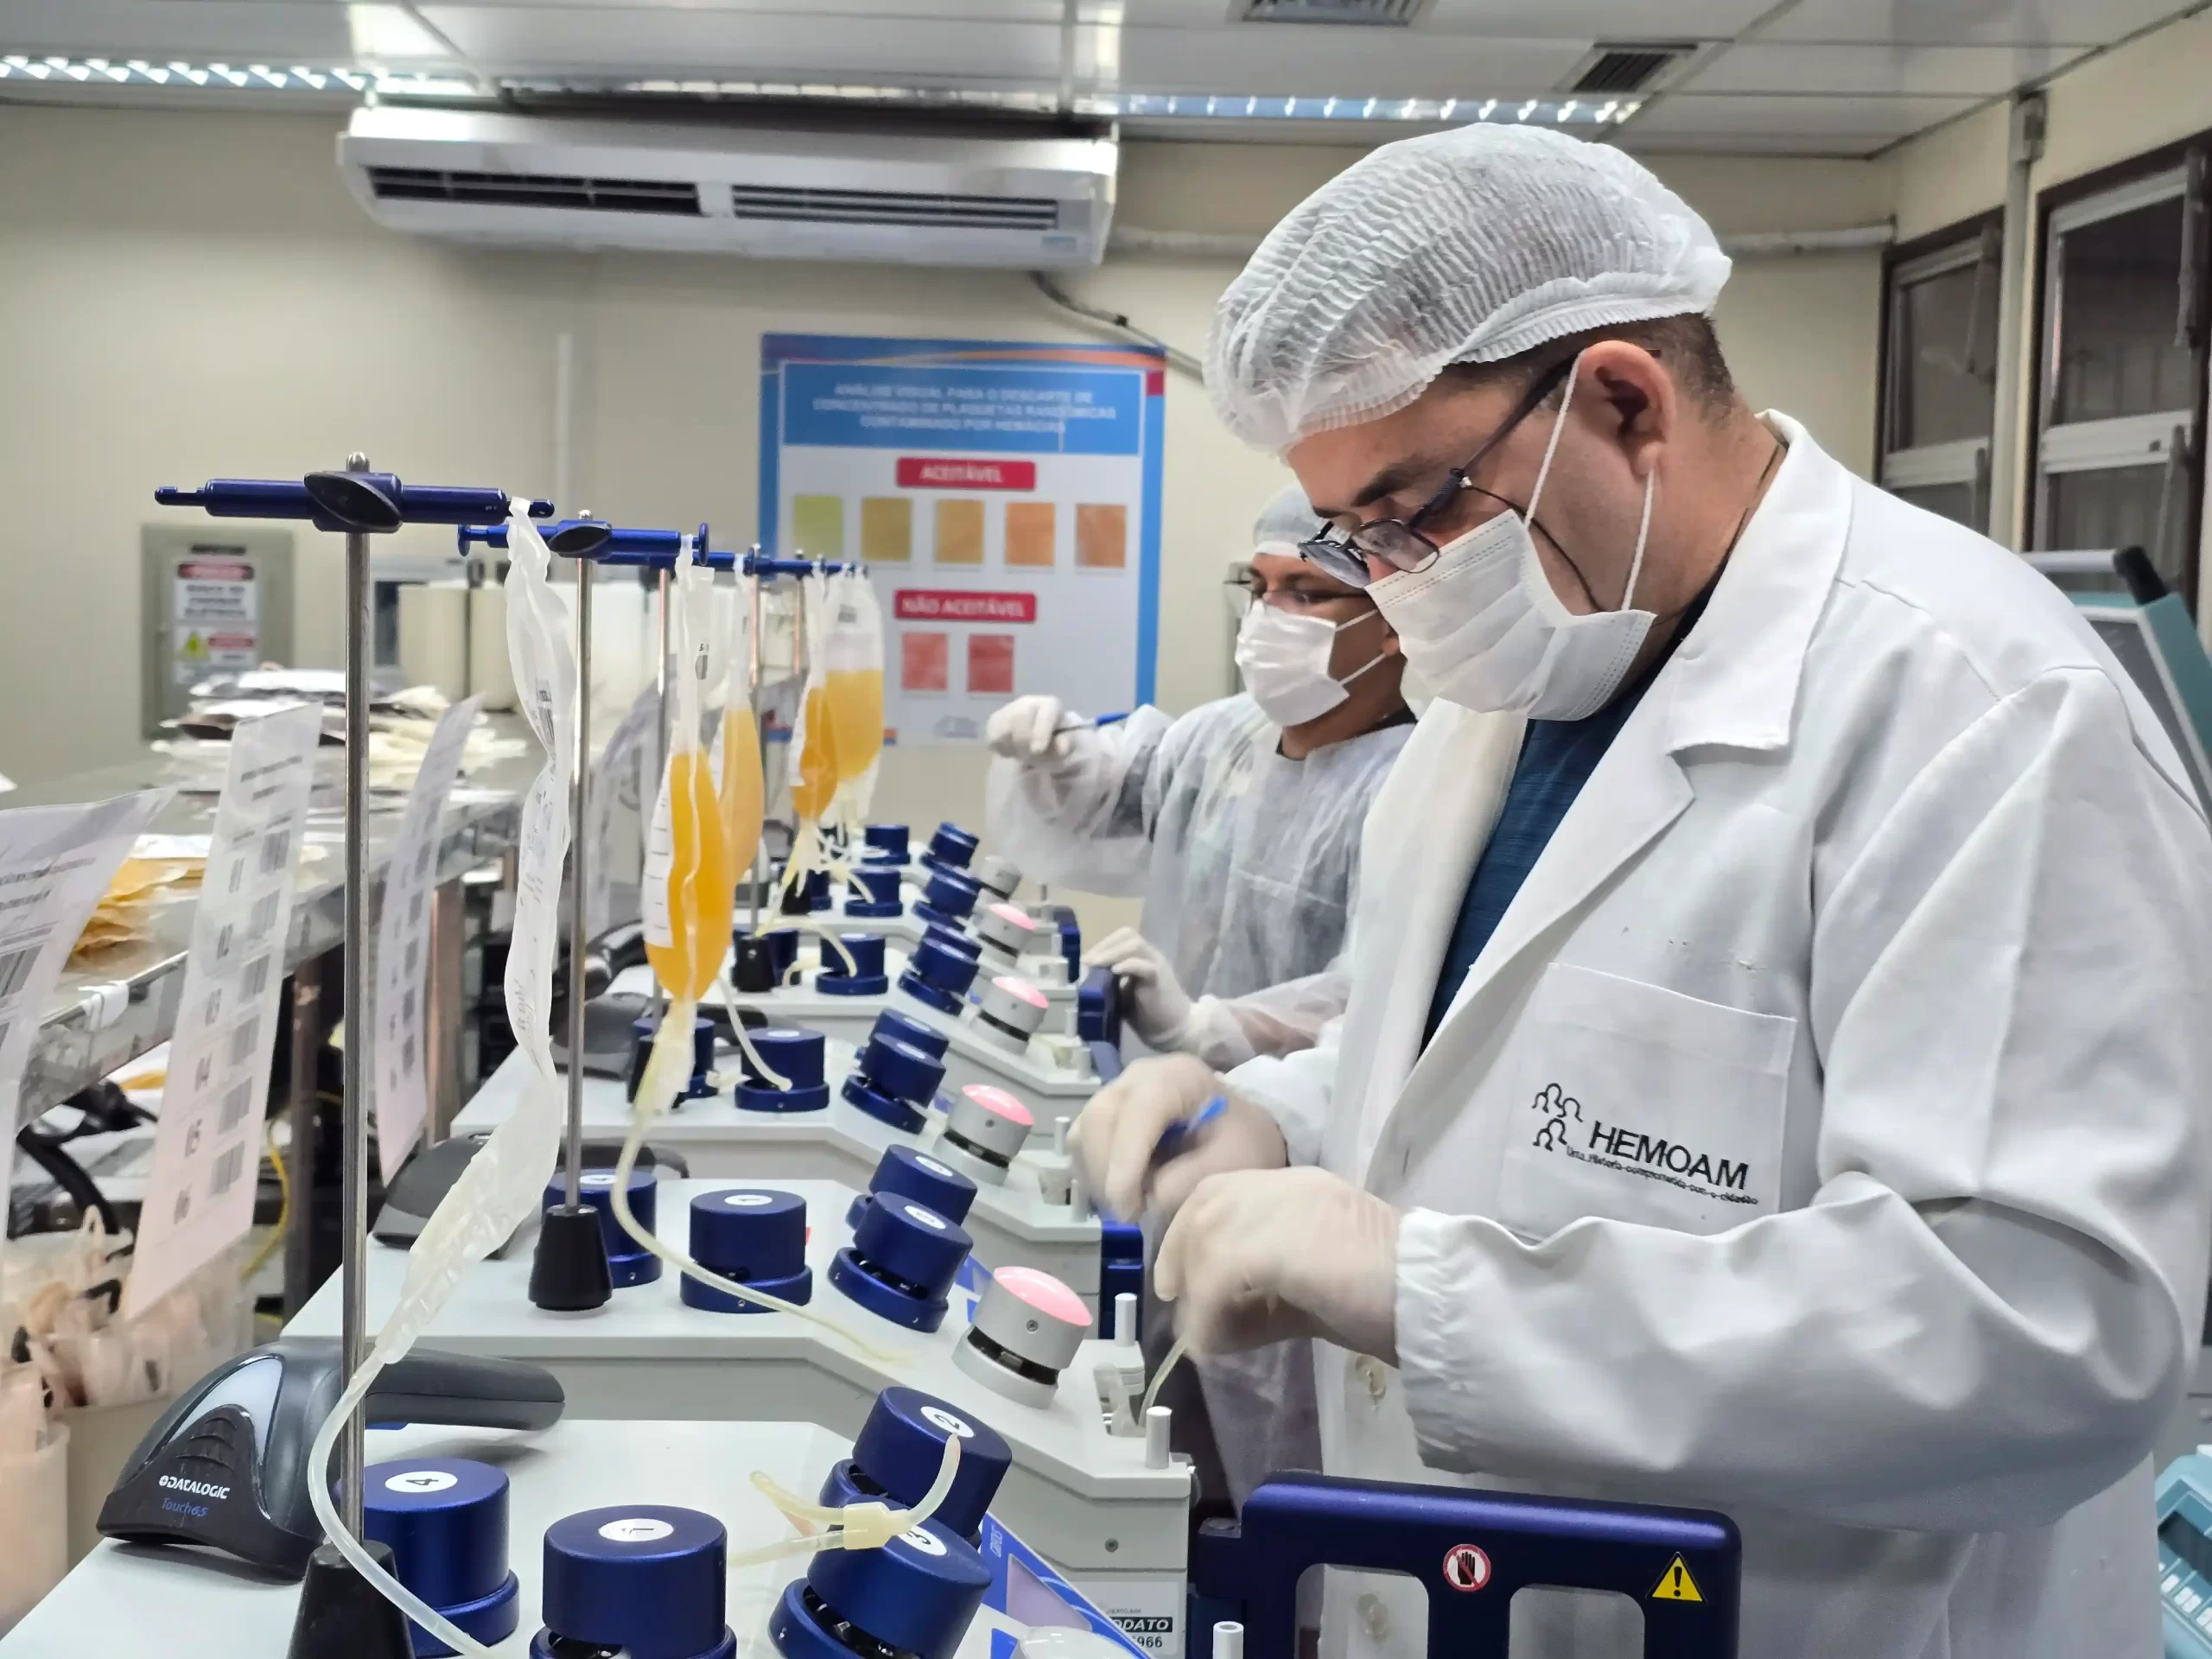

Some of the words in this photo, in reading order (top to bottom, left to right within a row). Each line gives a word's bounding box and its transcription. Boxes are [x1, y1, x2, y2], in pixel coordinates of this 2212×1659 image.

[919, 461, 1003, 483] ACEITÁVEL
[901, 594, 940, 614] NÃO
[942, 595, 1025, 618] ACEITÁVEL
[1588, 1120, 1750, 1191] HEMOAM
[933, 1413, 961, 1430] 2
[167, 1476, 230, 1500] DATALOGIC
[405, 1478, 439, 1486] 4
[1134, 1636, 1164, 1649] 966
